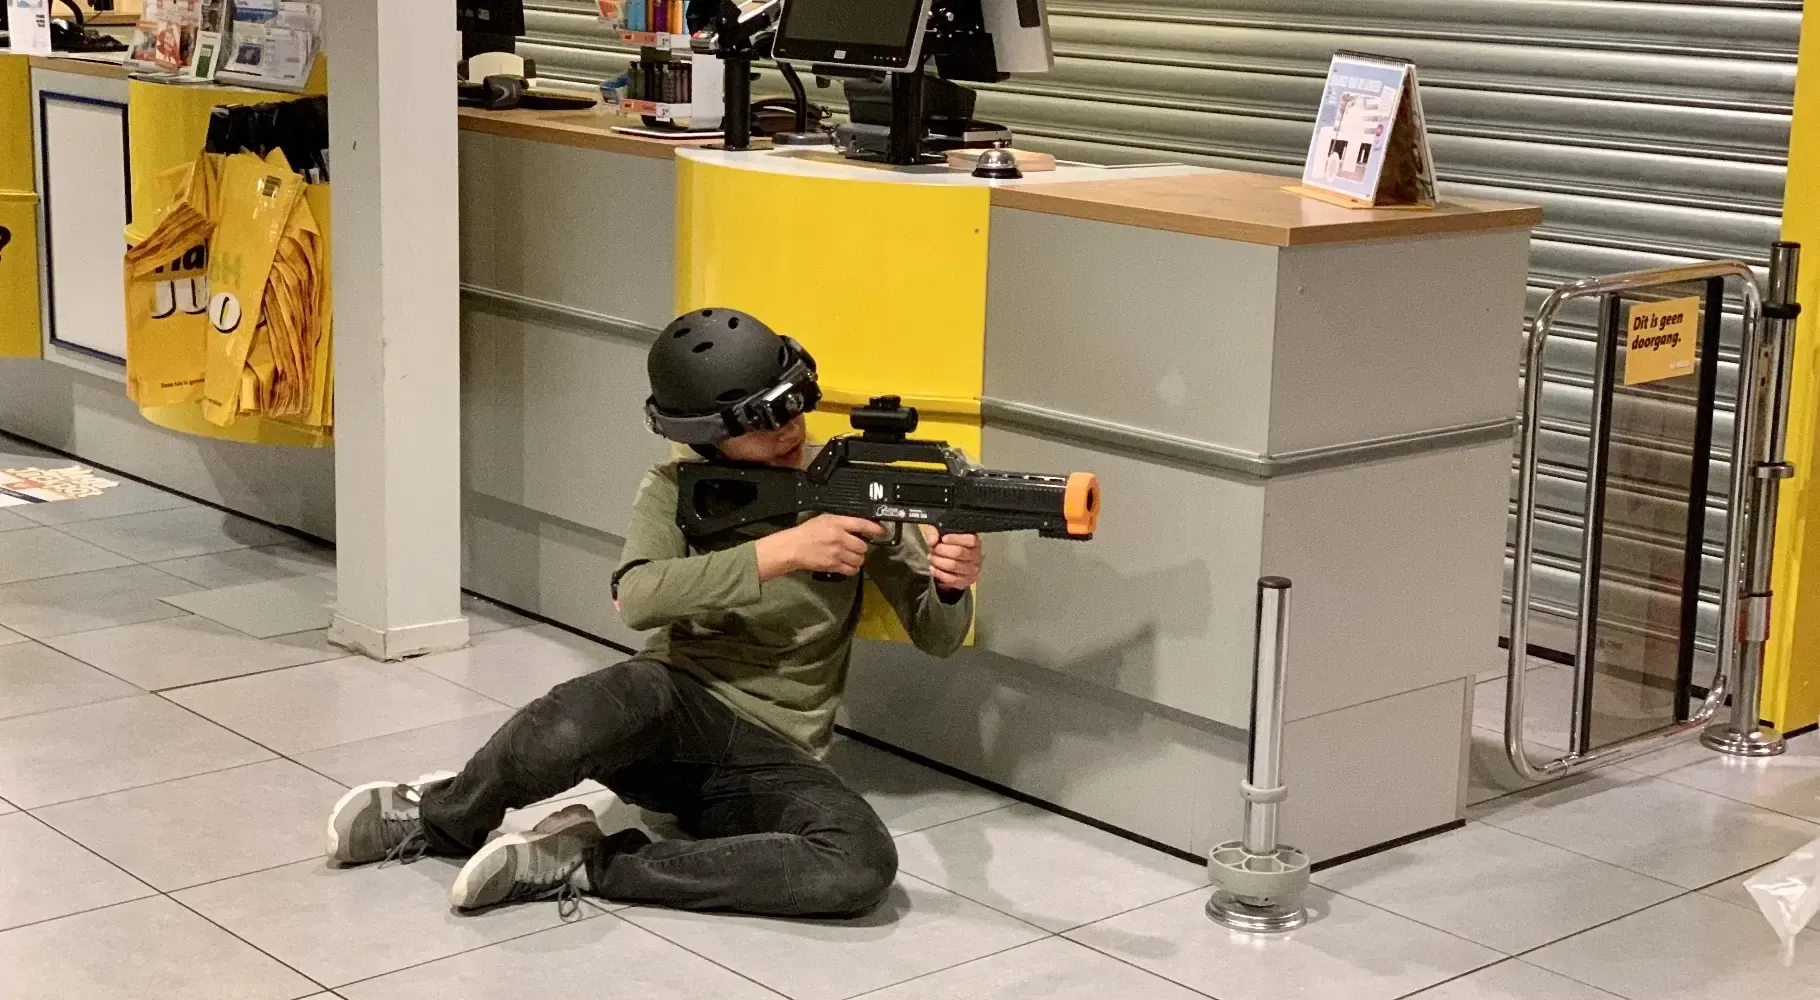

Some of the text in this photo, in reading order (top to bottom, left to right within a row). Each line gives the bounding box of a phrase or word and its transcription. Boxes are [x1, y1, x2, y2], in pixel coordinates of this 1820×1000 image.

[1633, 313, 1684, 331] Dit is geen
[1631, 332, 1682, 351] doorgang.
[869, 481, 884, 500] IN
